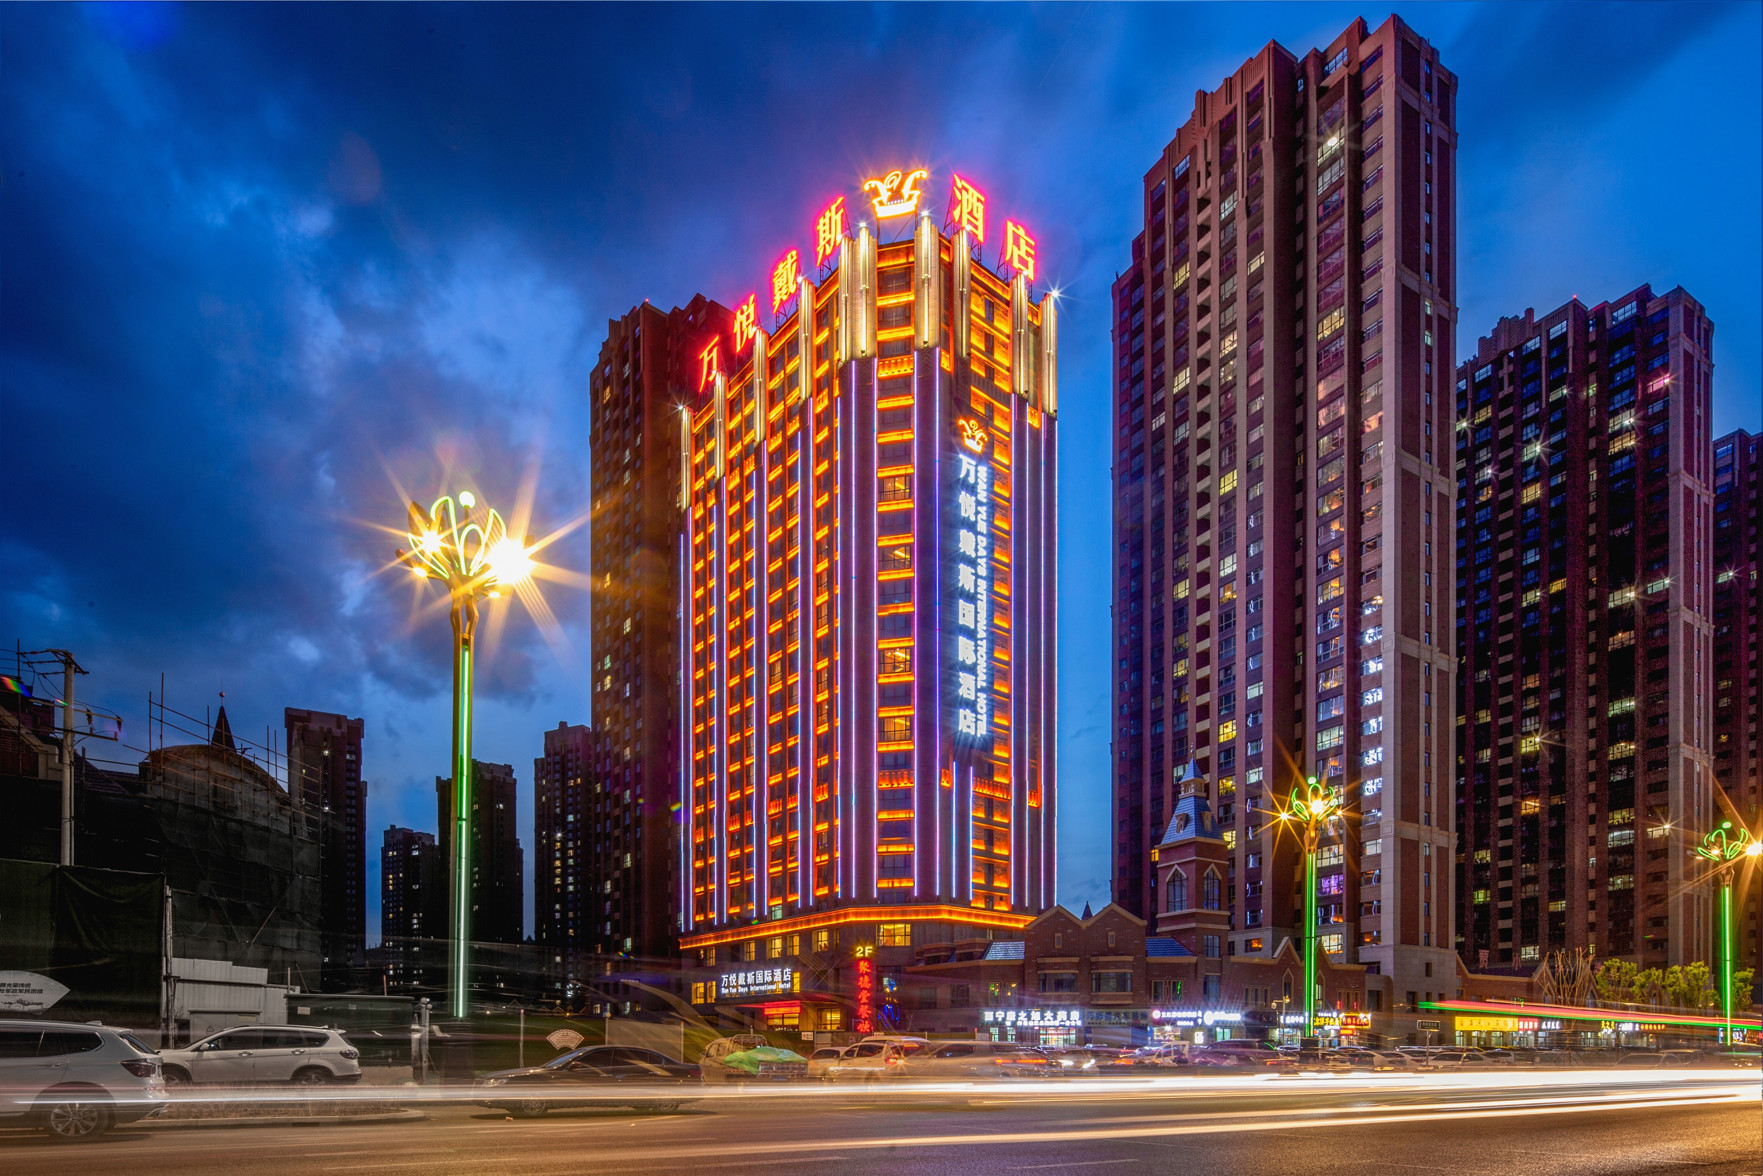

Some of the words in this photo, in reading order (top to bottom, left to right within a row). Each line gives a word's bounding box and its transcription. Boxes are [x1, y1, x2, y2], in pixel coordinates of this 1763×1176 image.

[699, 196, 844, 393] 万悦戴斯
[952, 173, 1036, 281] 酒店
[977, 465, 987, 502] WAN
[977, 506, 987, 535] YUE
[977, 535, 987, 577] DAYS
[977, 691, 987, 737] HOTEL
[856, 946, 873, 957] 2F
[721, 968, 792, 987] 万悦戴斯国际酒店
